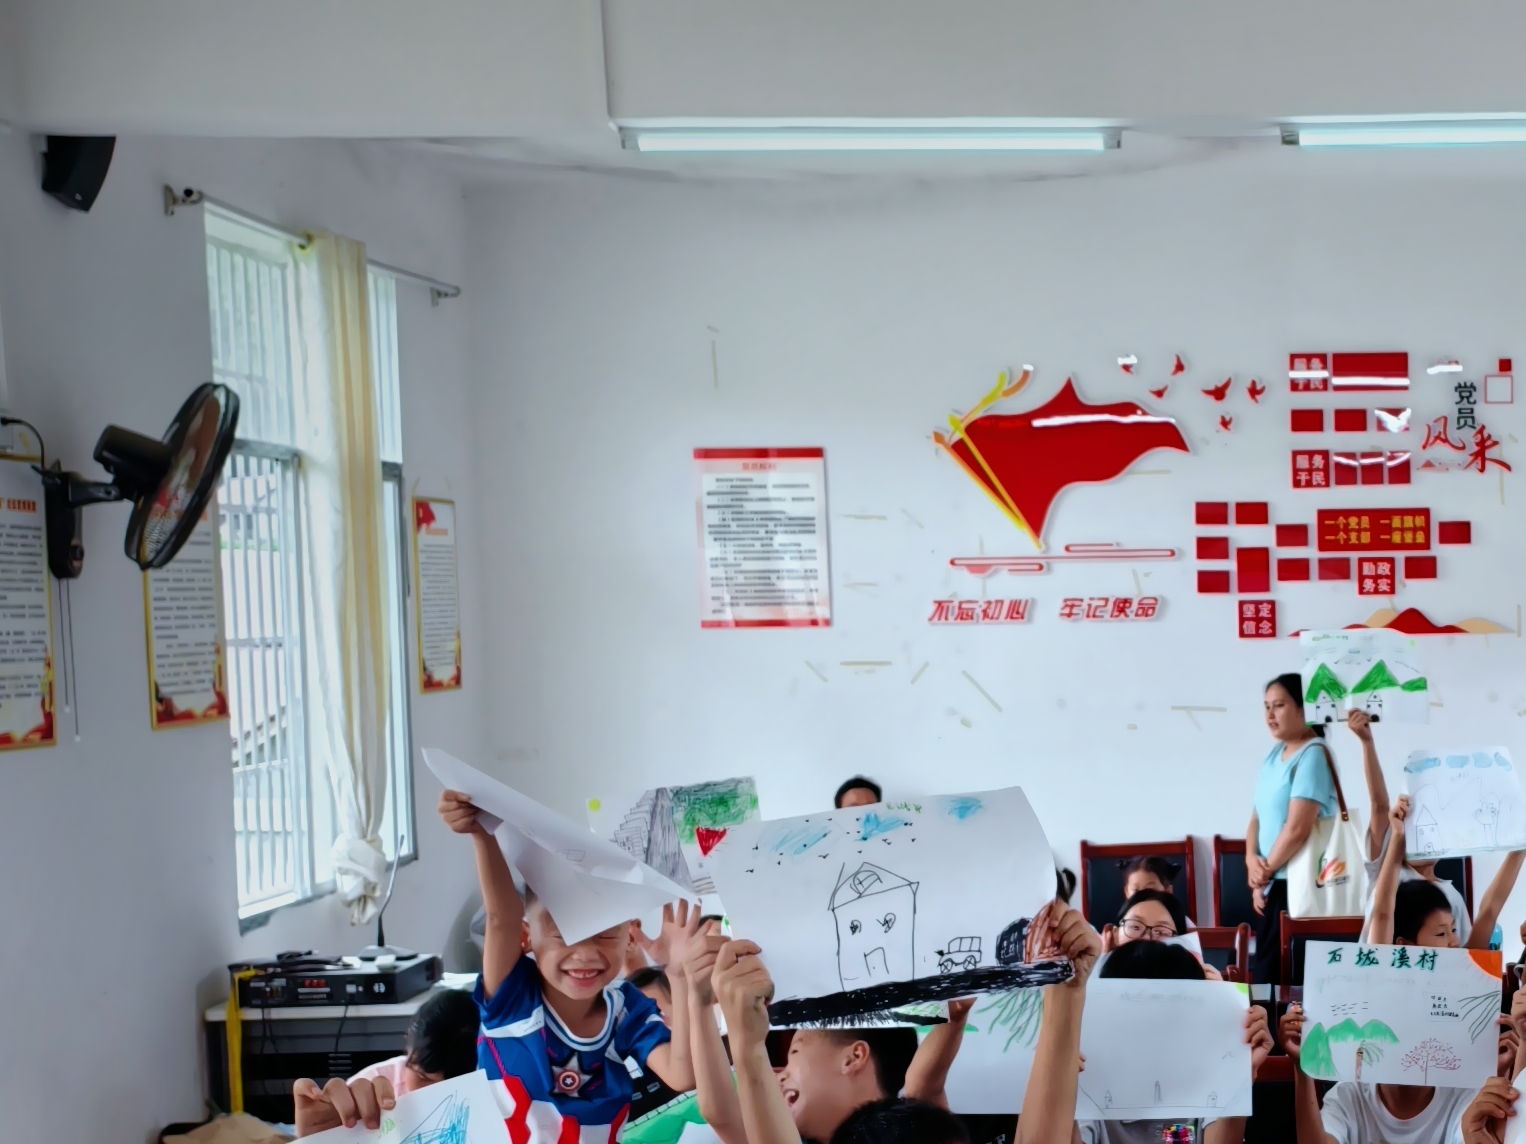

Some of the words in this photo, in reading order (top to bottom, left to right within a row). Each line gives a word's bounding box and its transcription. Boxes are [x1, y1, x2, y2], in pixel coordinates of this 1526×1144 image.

[1455, 382, 1477, 430] 党员
[1422, 416, 1512, 473] 风采
[1362, 562, 1391, 576] 勤政
[1362, 578, 1391, 593] 务实
[928, 599, 1029, 621] 不忘初心
[1060, 597, 1159, 619] 牢记使命
[1242, 620, 1273, 635] 信念
